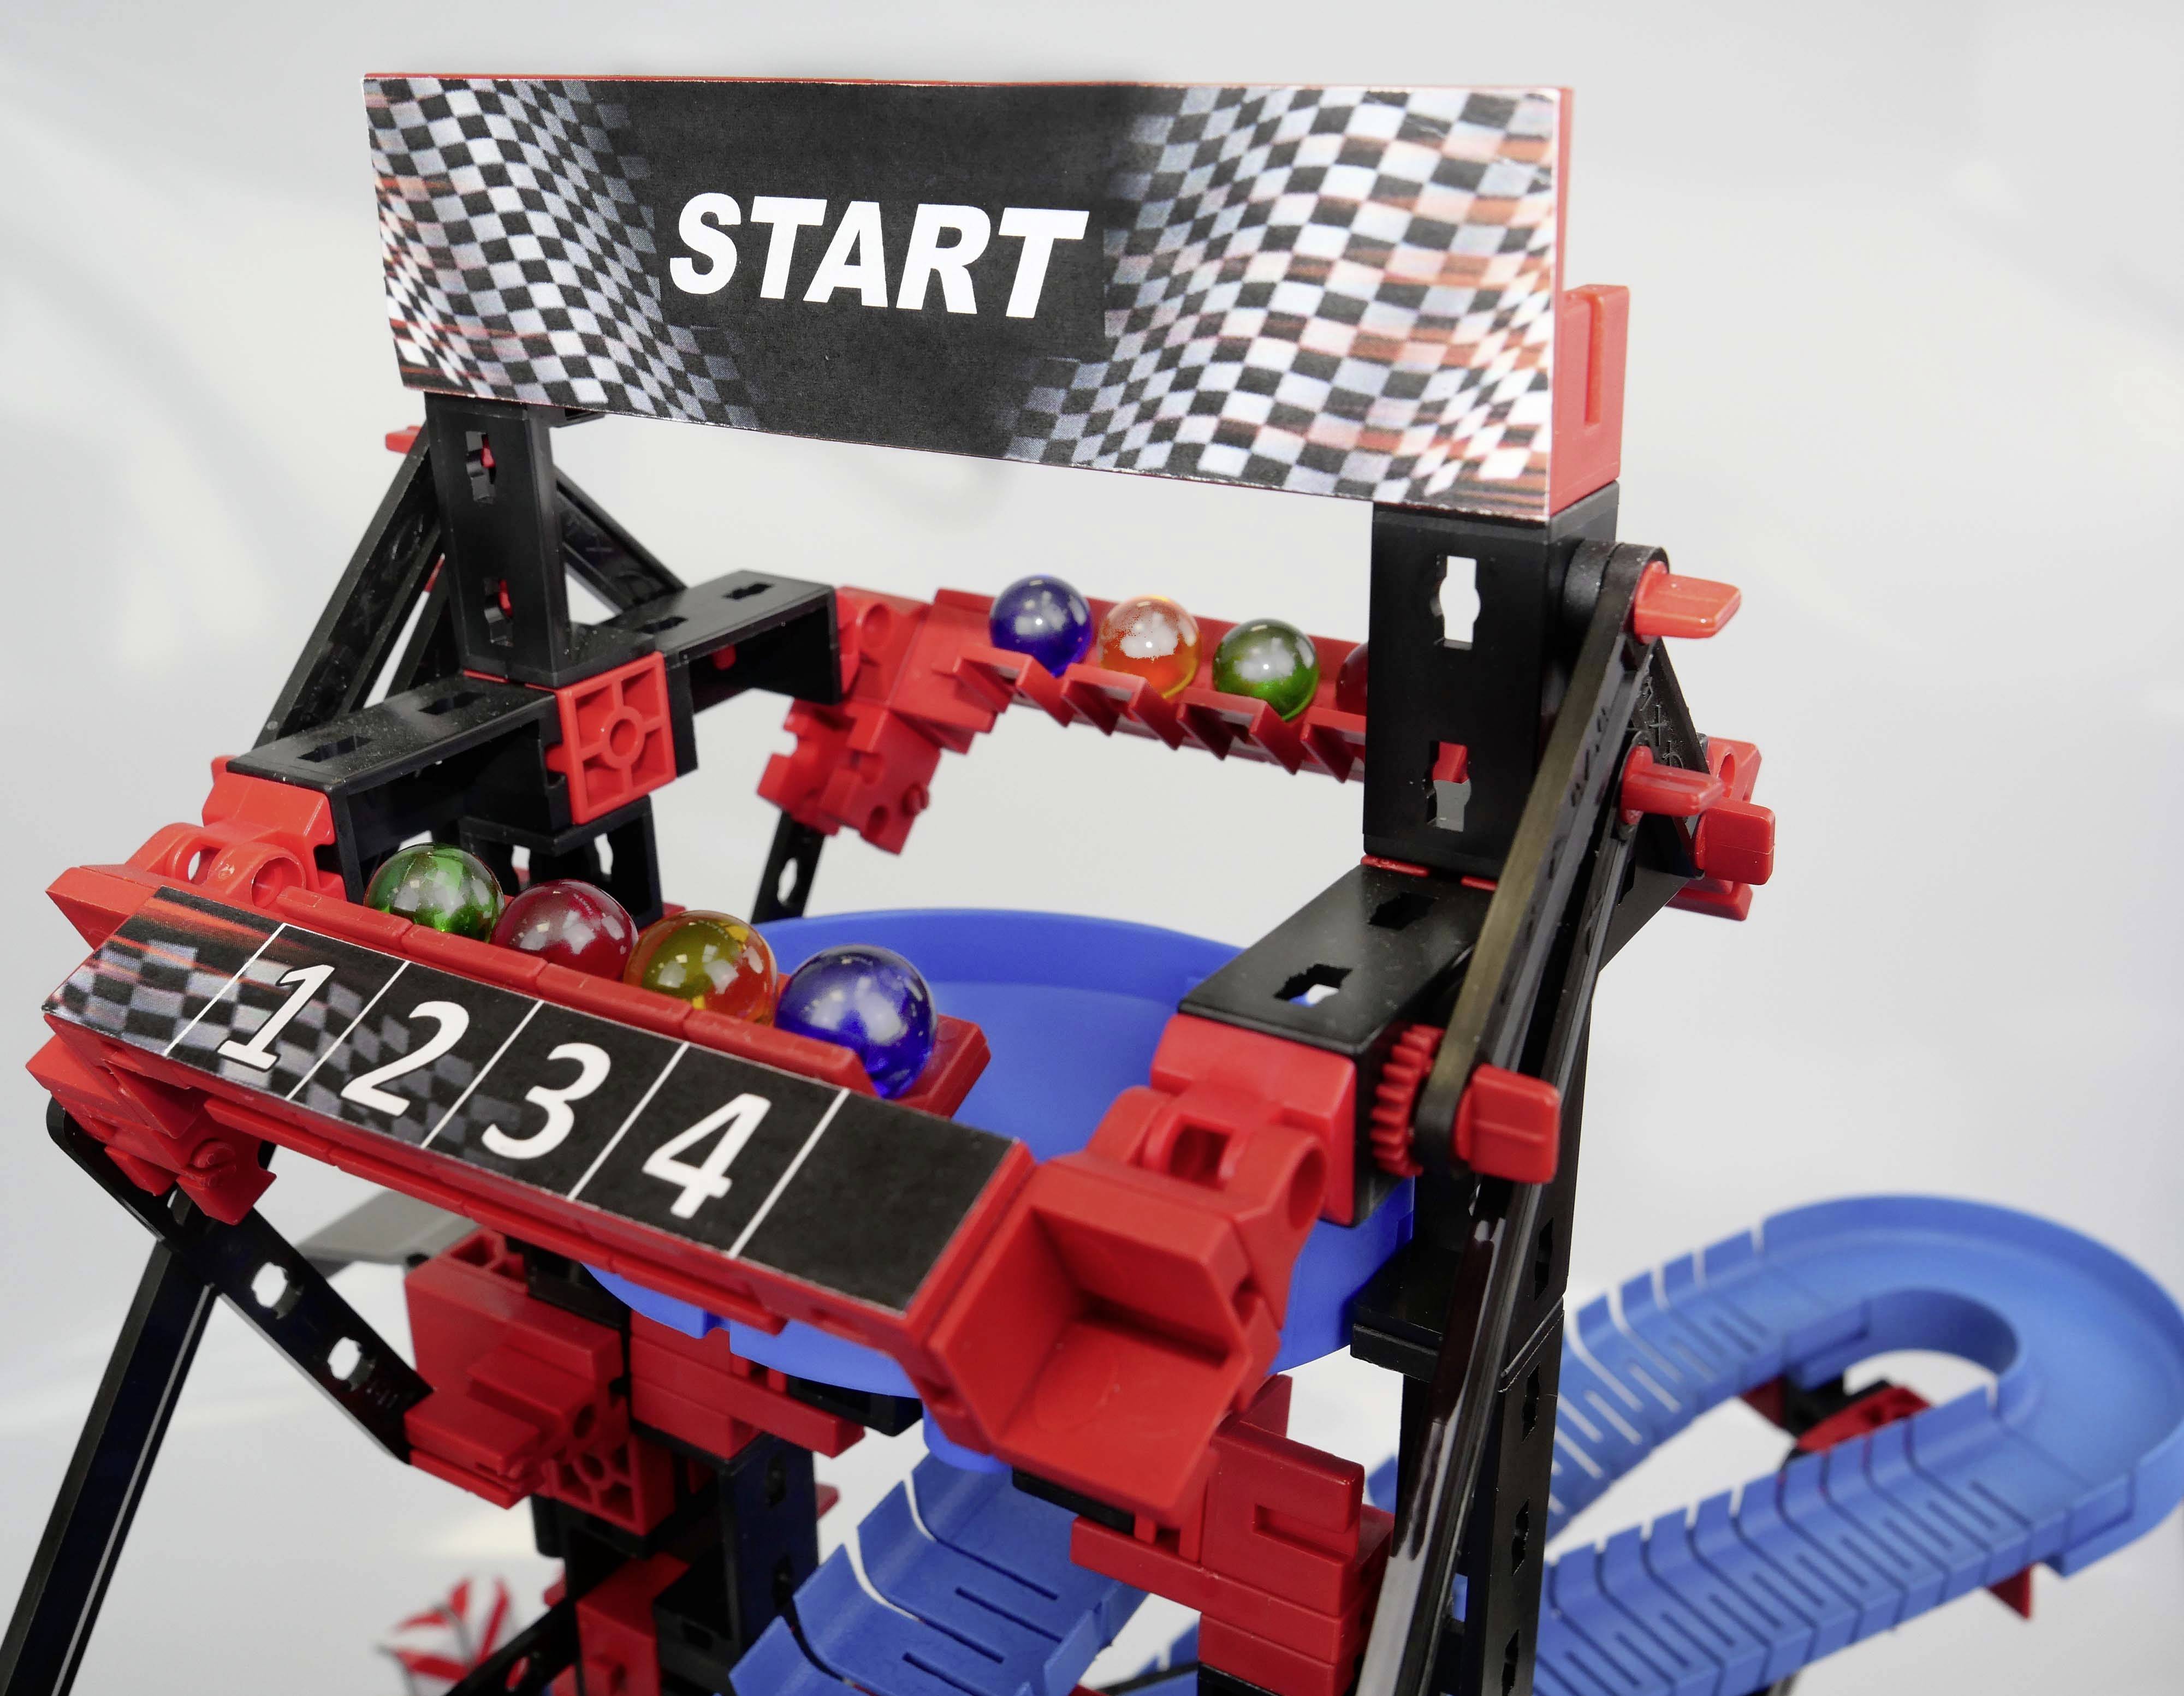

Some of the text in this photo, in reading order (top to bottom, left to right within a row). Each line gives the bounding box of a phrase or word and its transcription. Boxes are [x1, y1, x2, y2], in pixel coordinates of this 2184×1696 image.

[670, 193, 1089, 318] START
[218, 964, 770, 1218] 1 2 3 4
